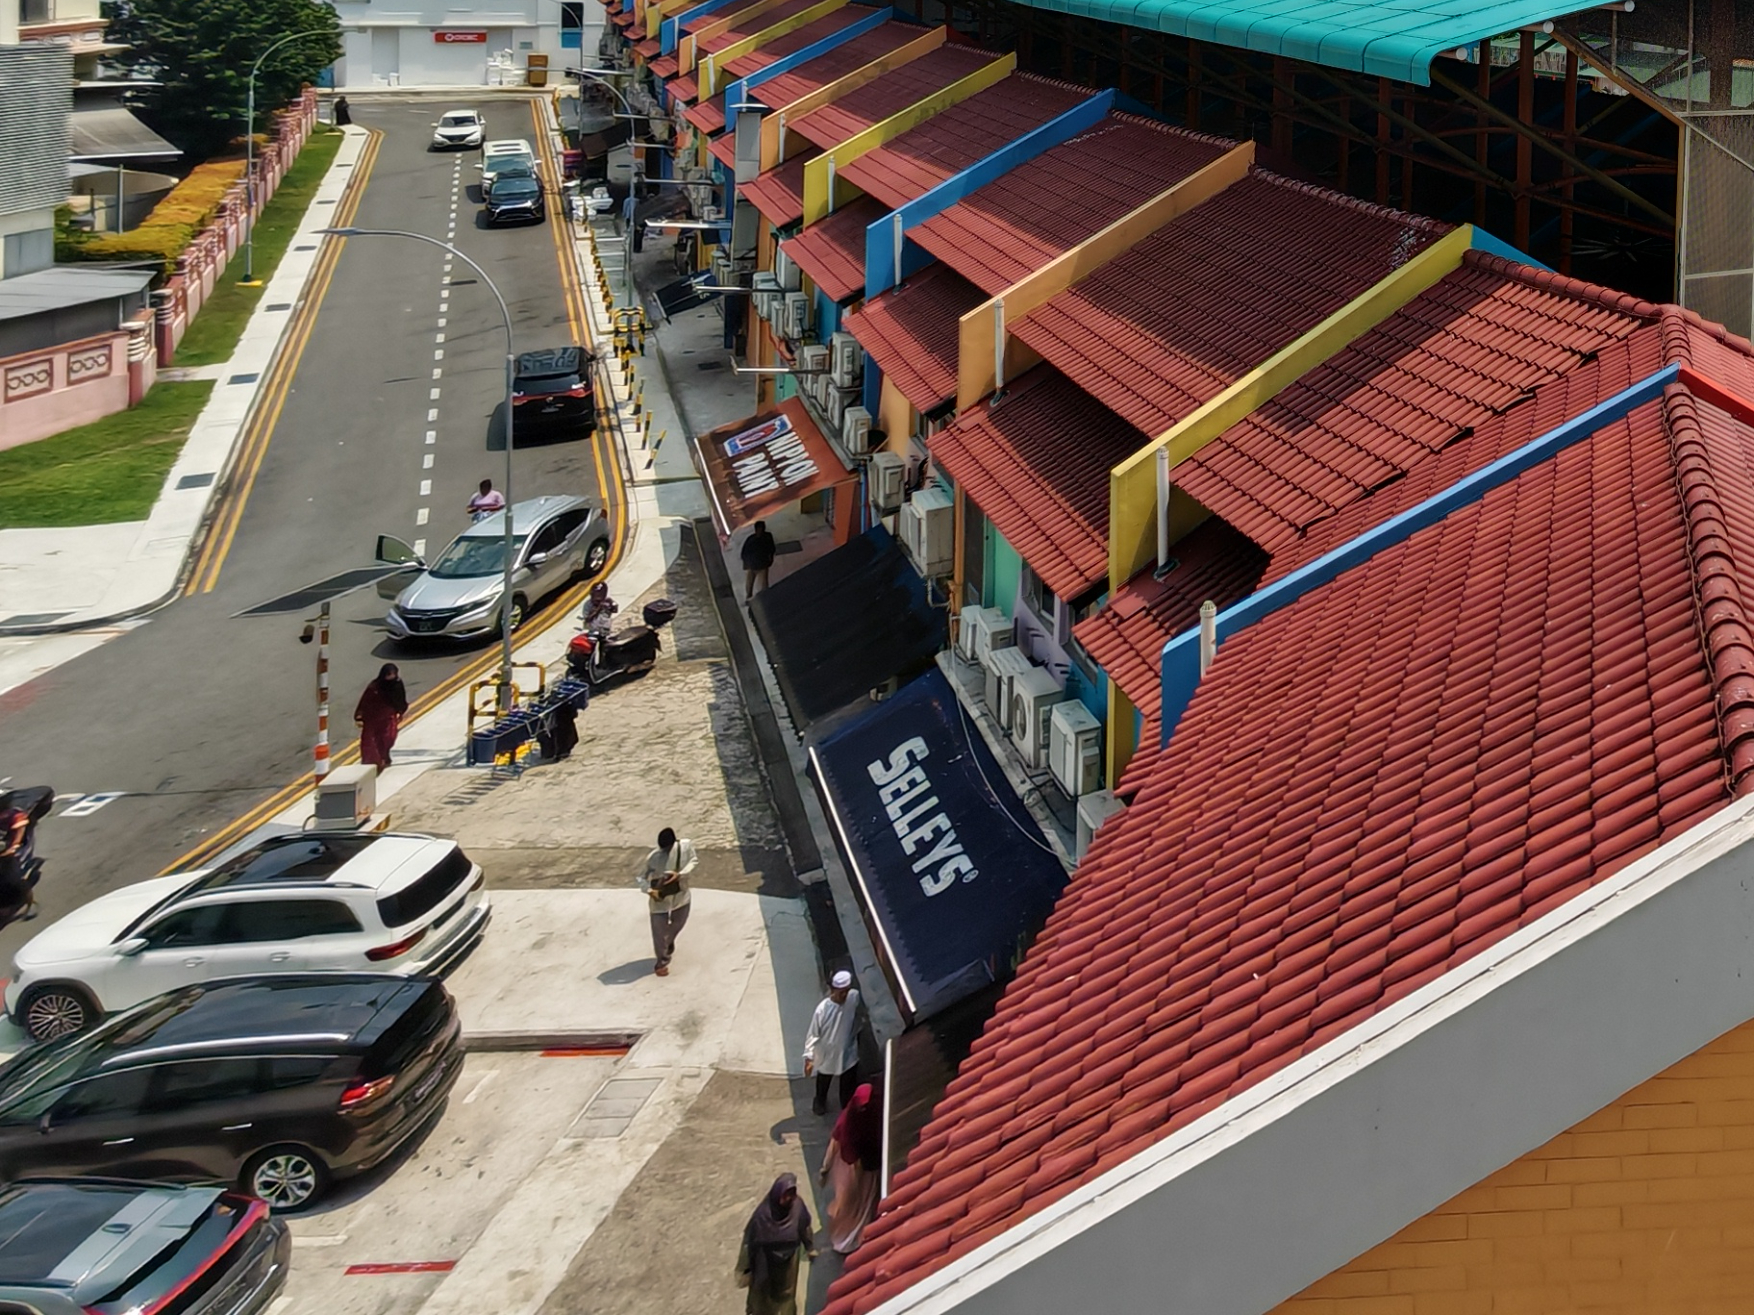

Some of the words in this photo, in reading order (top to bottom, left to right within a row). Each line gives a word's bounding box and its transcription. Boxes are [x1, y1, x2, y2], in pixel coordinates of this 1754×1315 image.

[732, 452, 779, 498] PAINT
[765, 431, 820, 486] NIPPON
[866, 736, 974, 897] SELLEYS
